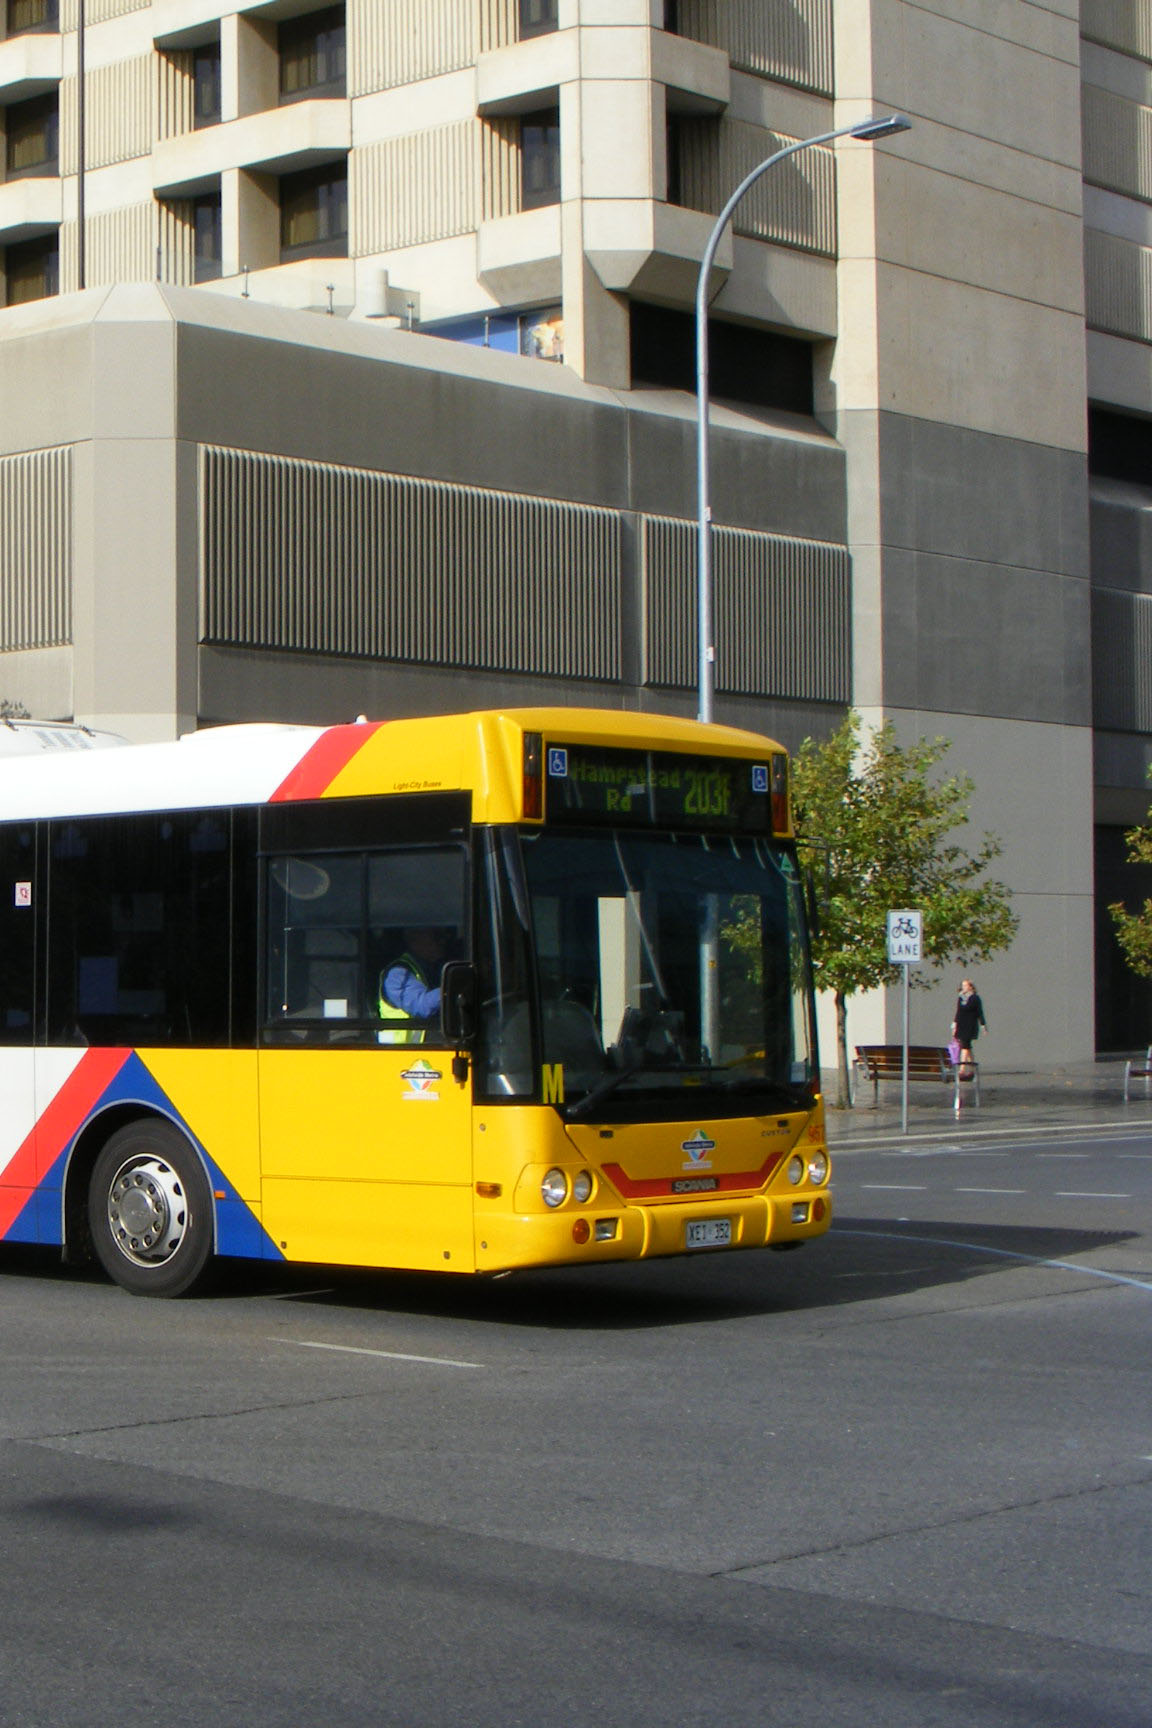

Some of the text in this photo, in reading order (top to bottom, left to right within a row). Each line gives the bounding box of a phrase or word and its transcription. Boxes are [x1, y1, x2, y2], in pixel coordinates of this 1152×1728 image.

[891, 944, 918, 955] LANE
[542, 1063, 564, 1104] M
[715, 1222, 729, 1239] 352
